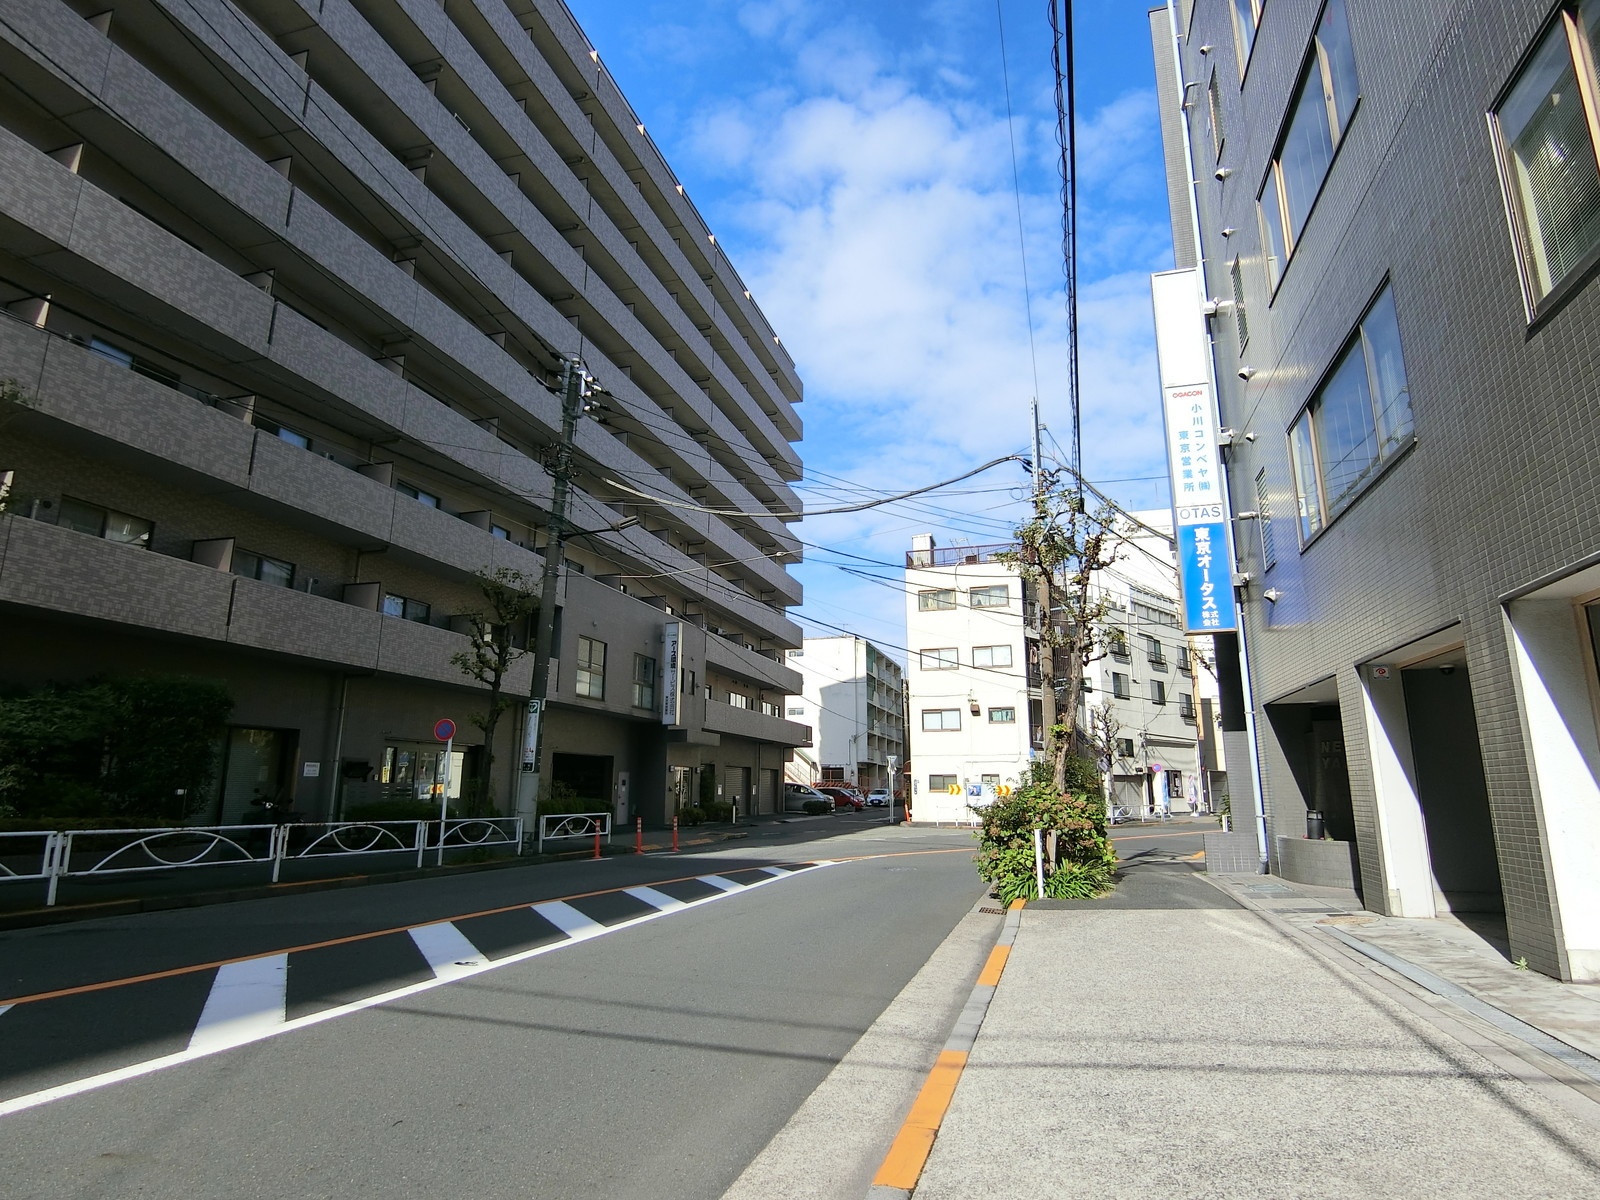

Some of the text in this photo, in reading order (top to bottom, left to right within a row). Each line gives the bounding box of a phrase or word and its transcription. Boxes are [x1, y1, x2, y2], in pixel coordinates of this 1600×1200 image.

[1172, 390, 1203, 399] OGACON
[1179, 430, 1194, 493] 東京営業所
[1179, 506, 1221, 520] OTAS
